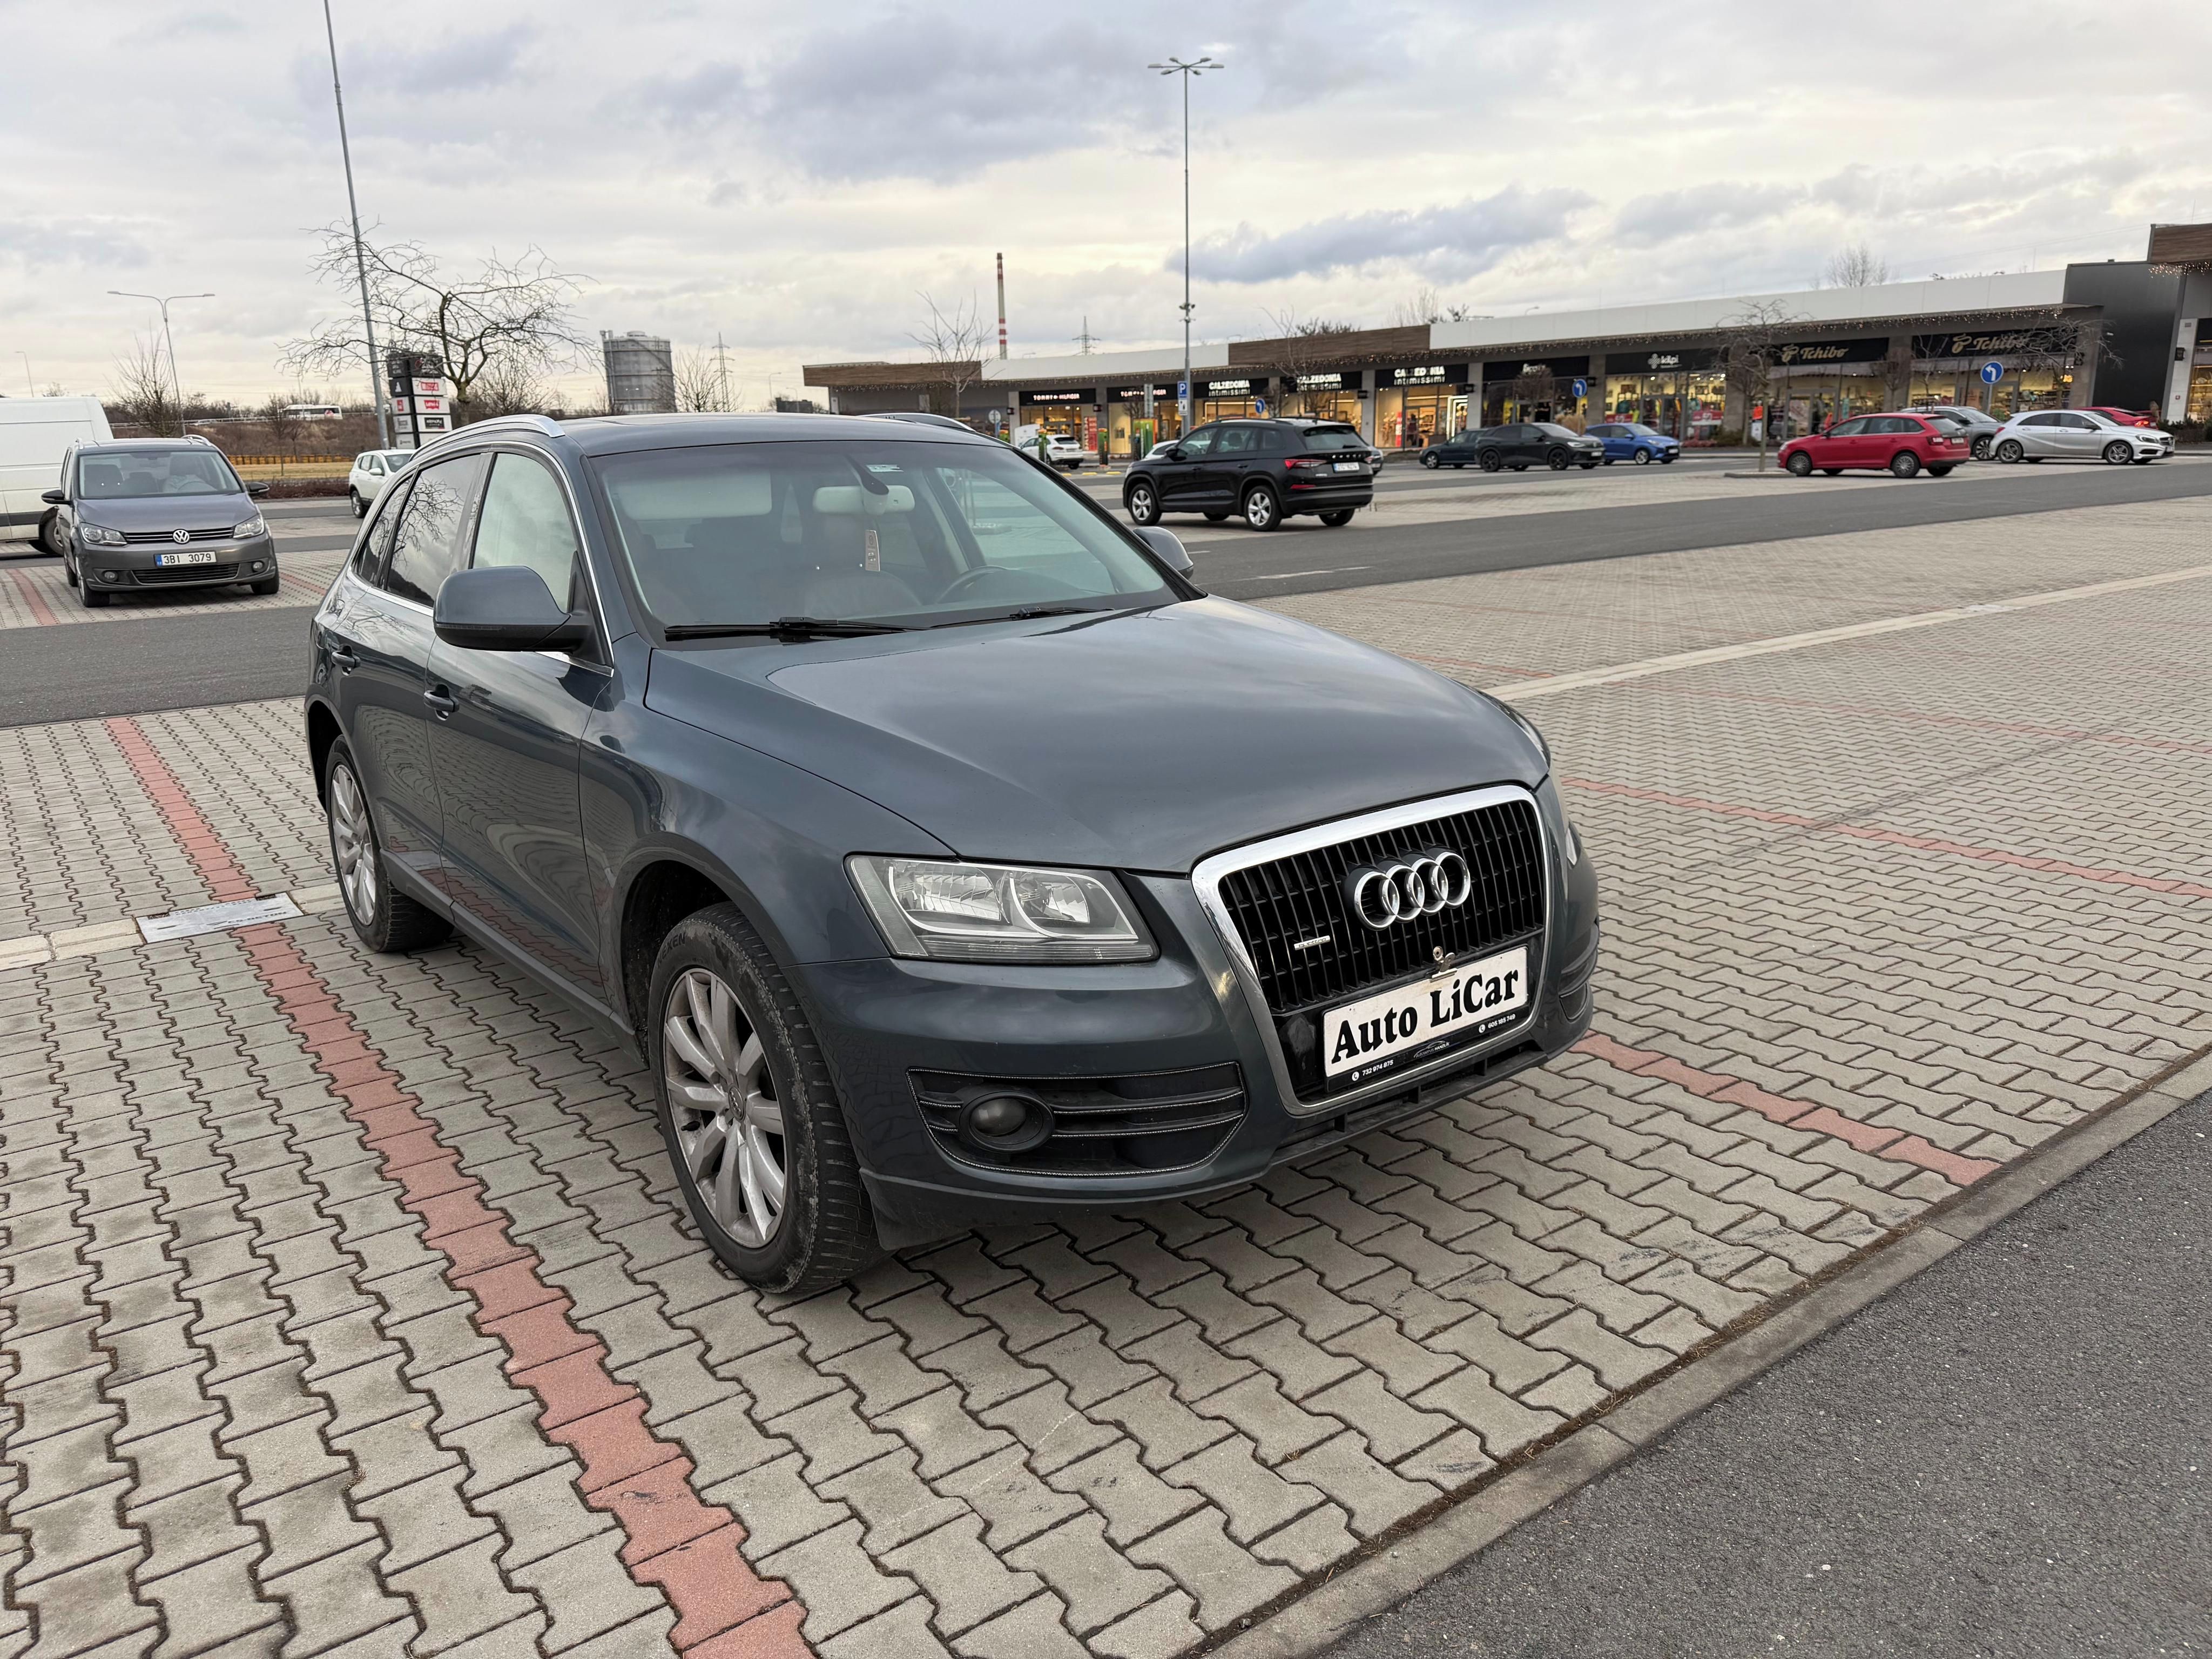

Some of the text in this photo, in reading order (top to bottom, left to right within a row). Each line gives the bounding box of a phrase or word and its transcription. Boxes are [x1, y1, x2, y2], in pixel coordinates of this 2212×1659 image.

[1800, 346, 1849, 359] Tchibo
[1661, 354, 1679, 365] kilpi
[1394, 366, 1445, 377] CALZEDONIA
[1209, 380, 1250, 390] CALZEDONIA
[1394, 376, 1445, 385] intimissimi
[1209, 388, 1250, 396] intimissimi
[188, 553, 211, 562] 3079
[1331, 969, 1519, 1064] Auto LiCar
[1362, 1060, 1393, 1076] 732 974 875
